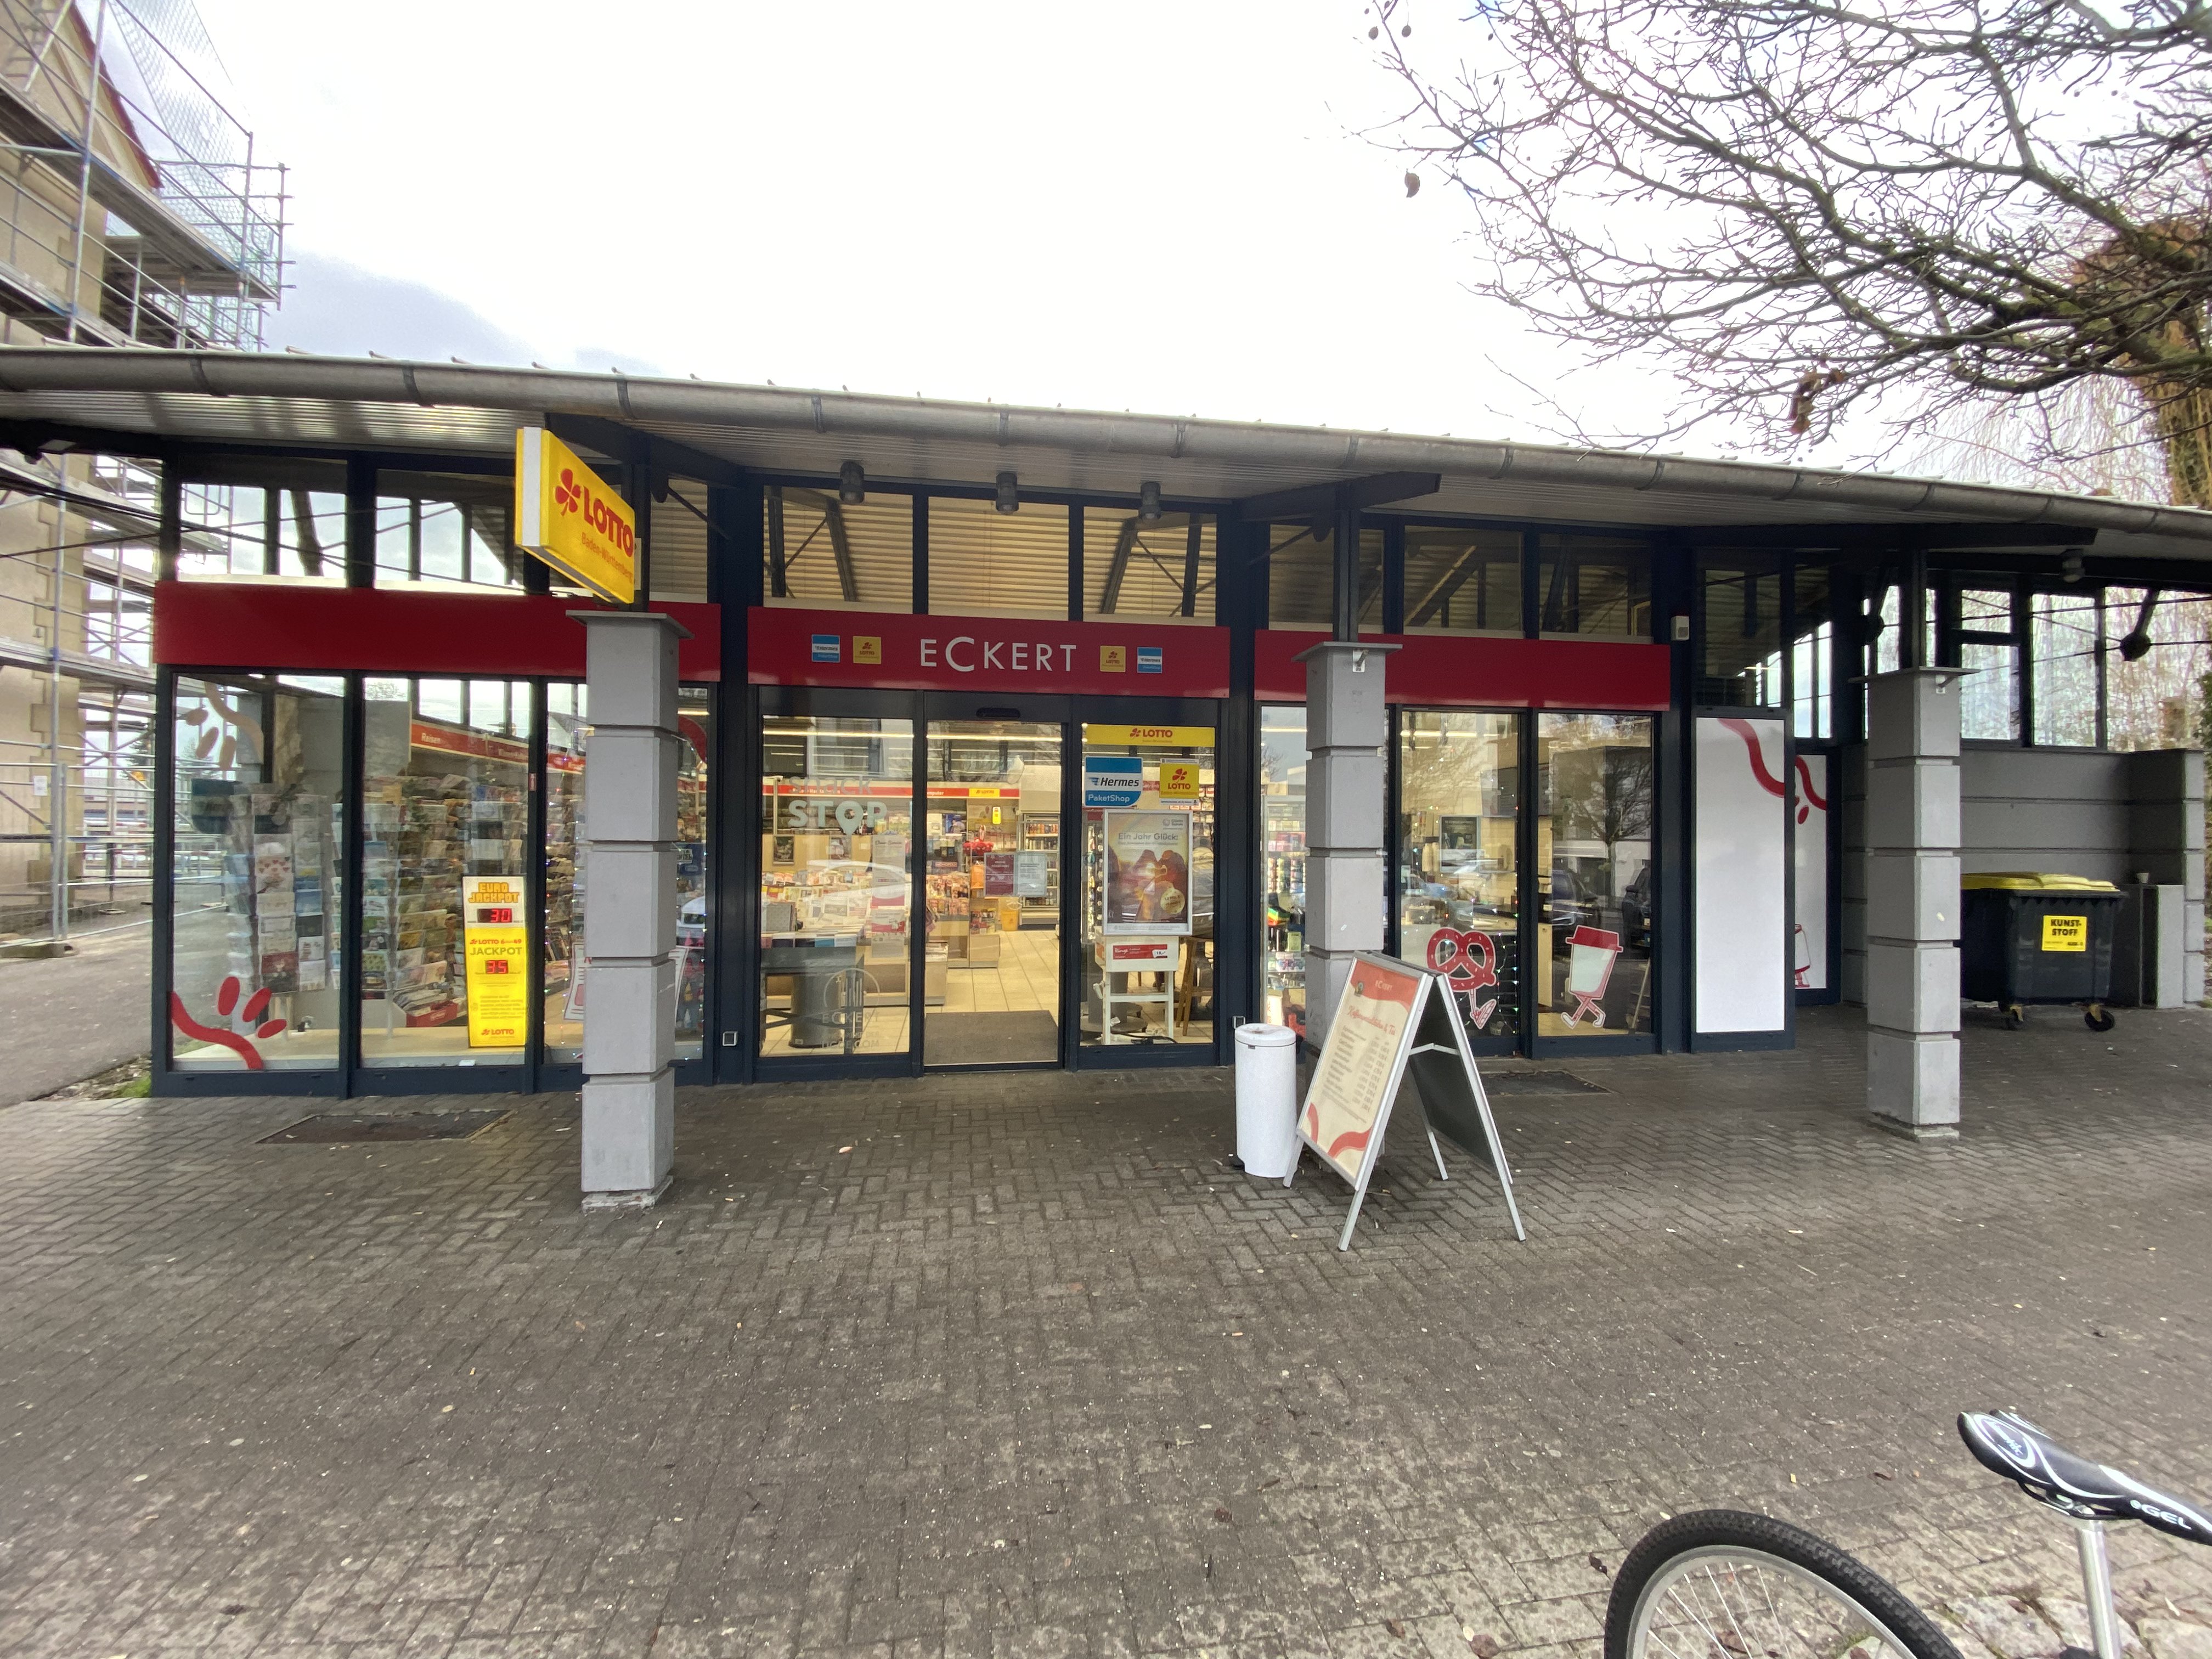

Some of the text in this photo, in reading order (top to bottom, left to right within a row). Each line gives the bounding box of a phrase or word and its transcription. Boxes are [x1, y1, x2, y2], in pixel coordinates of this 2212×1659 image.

[583, 486, 633, 557] LOTTO
[921, 636, 1076, 672] ECKERT
[1143, 729, 1173, 738] LOTTO
[789, 775, 873, 795] snack
[1100, 777, 1139, 787] Hermes
[1088, 794, 1130, 803] PaketShop
[788, 799, 887, 831] STOP
[478, 882, 509, 893] EURO
[468, 892, 520, 903] JACKPOT
[490, 909, 511, 923] 30
[470, 947, 523, 956] JACKPOT
[486, 960, 507, 974] 35
